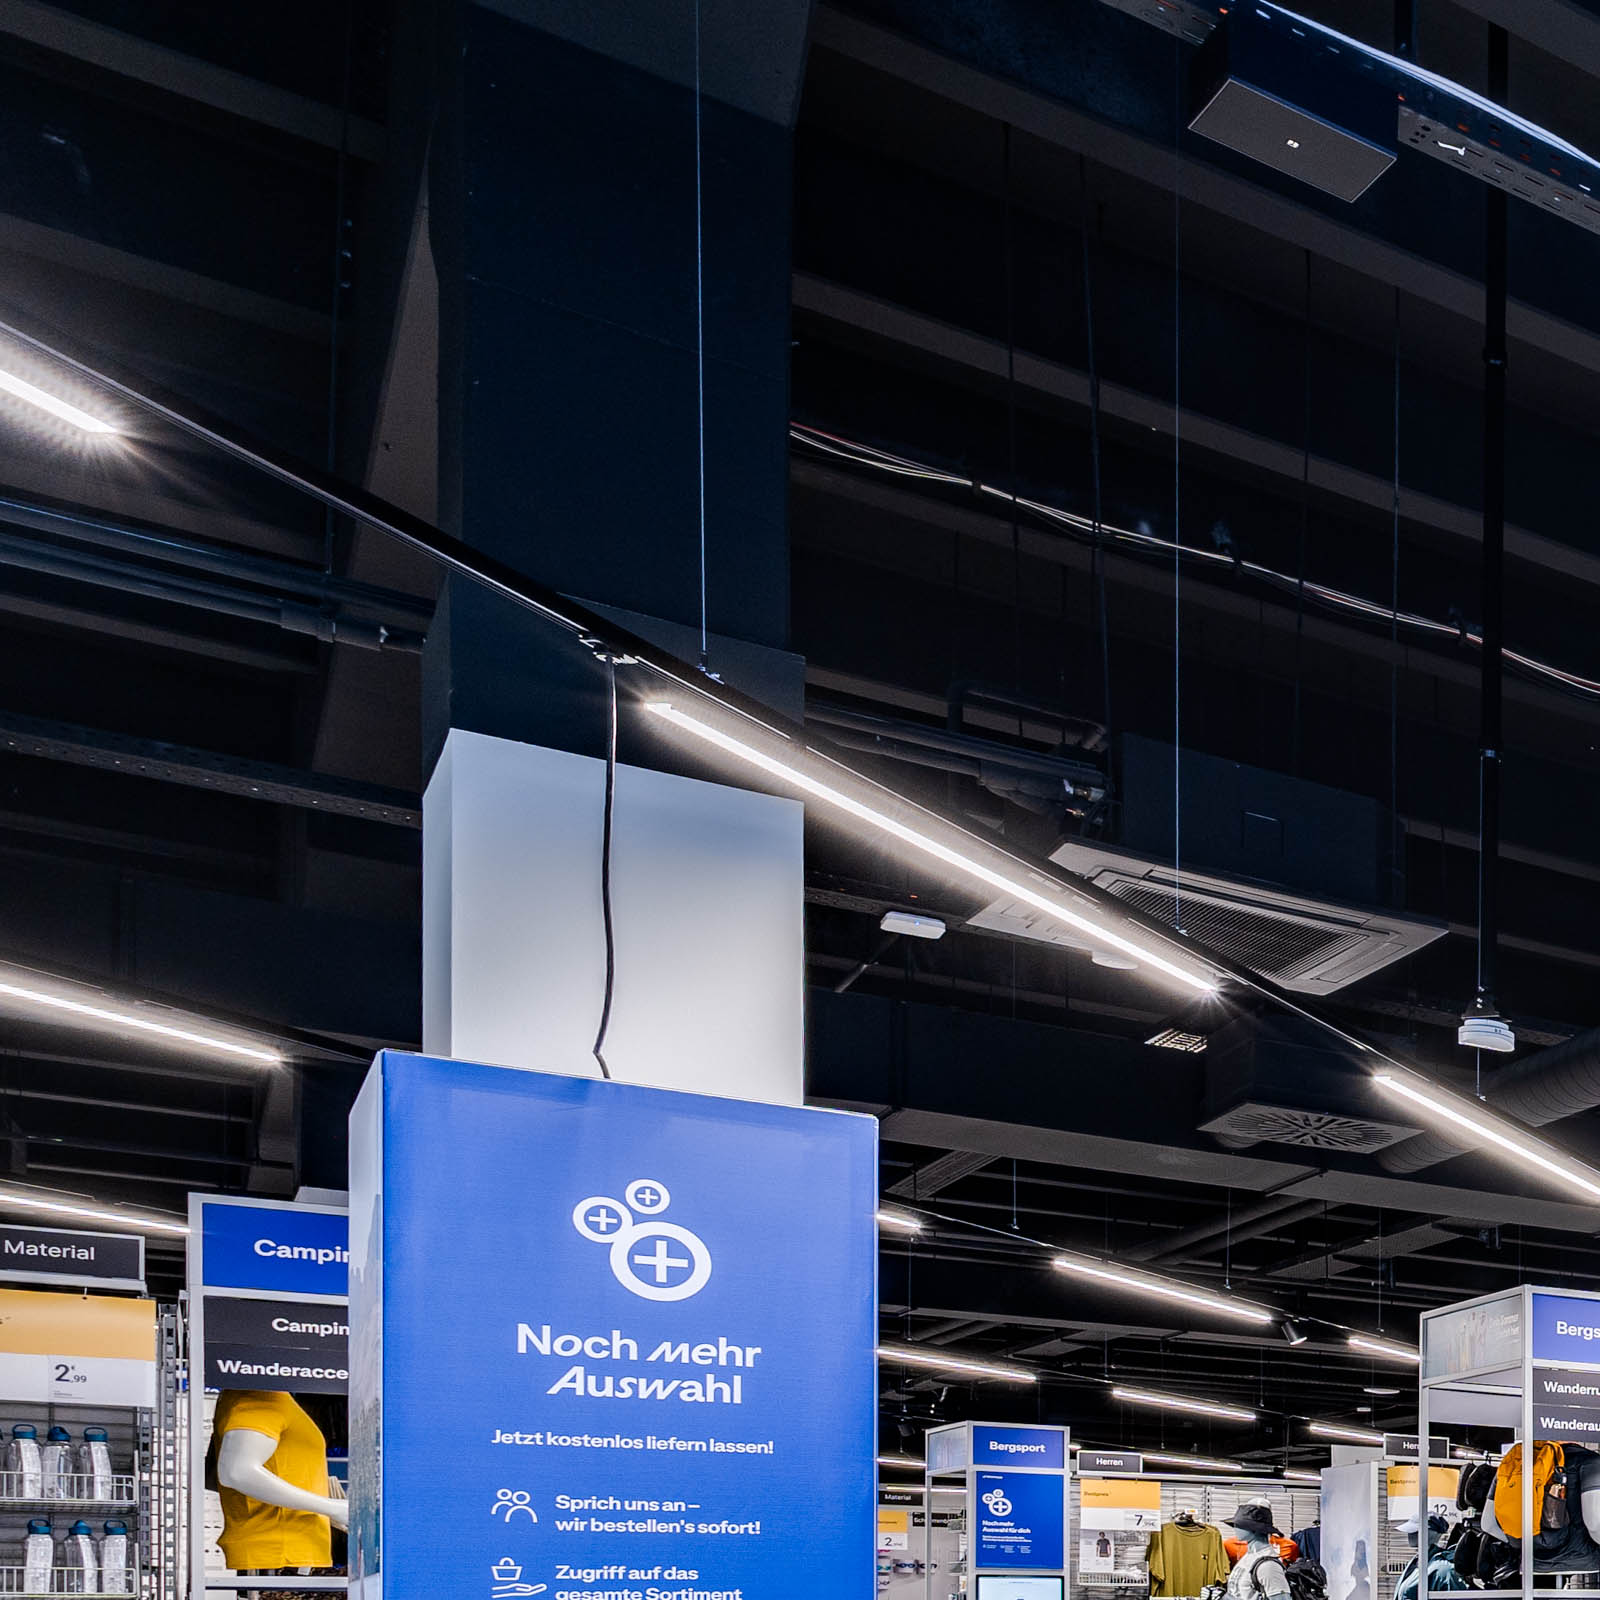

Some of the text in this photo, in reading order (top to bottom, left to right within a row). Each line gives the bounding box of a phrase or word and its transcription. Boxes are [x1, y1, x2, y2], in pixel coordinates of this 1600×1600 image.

[4, 1239, 95, 1260] Material
[517, 1323, 761, 1368] Noch mehr
[546, 1365, 742, 1404] Auswahl
[491, 1429, 774, 1454] Jetzt kostenlos liefern lassen!
[989, 1440, 1046, 1453] Bergsport
[1096, 1457, 1124, 1467] Herren
[555, 1495, 622, 1512] Sprich
[624, 1500, 660, 1512] uns
[662, 1501, 686, 1513] an
[884, 1493, 912, 1501] Material
[555, 1518, 762, 1535] wir bestellen's sofort!
[555, 1565, 699, 1584] Zugriff auf das
